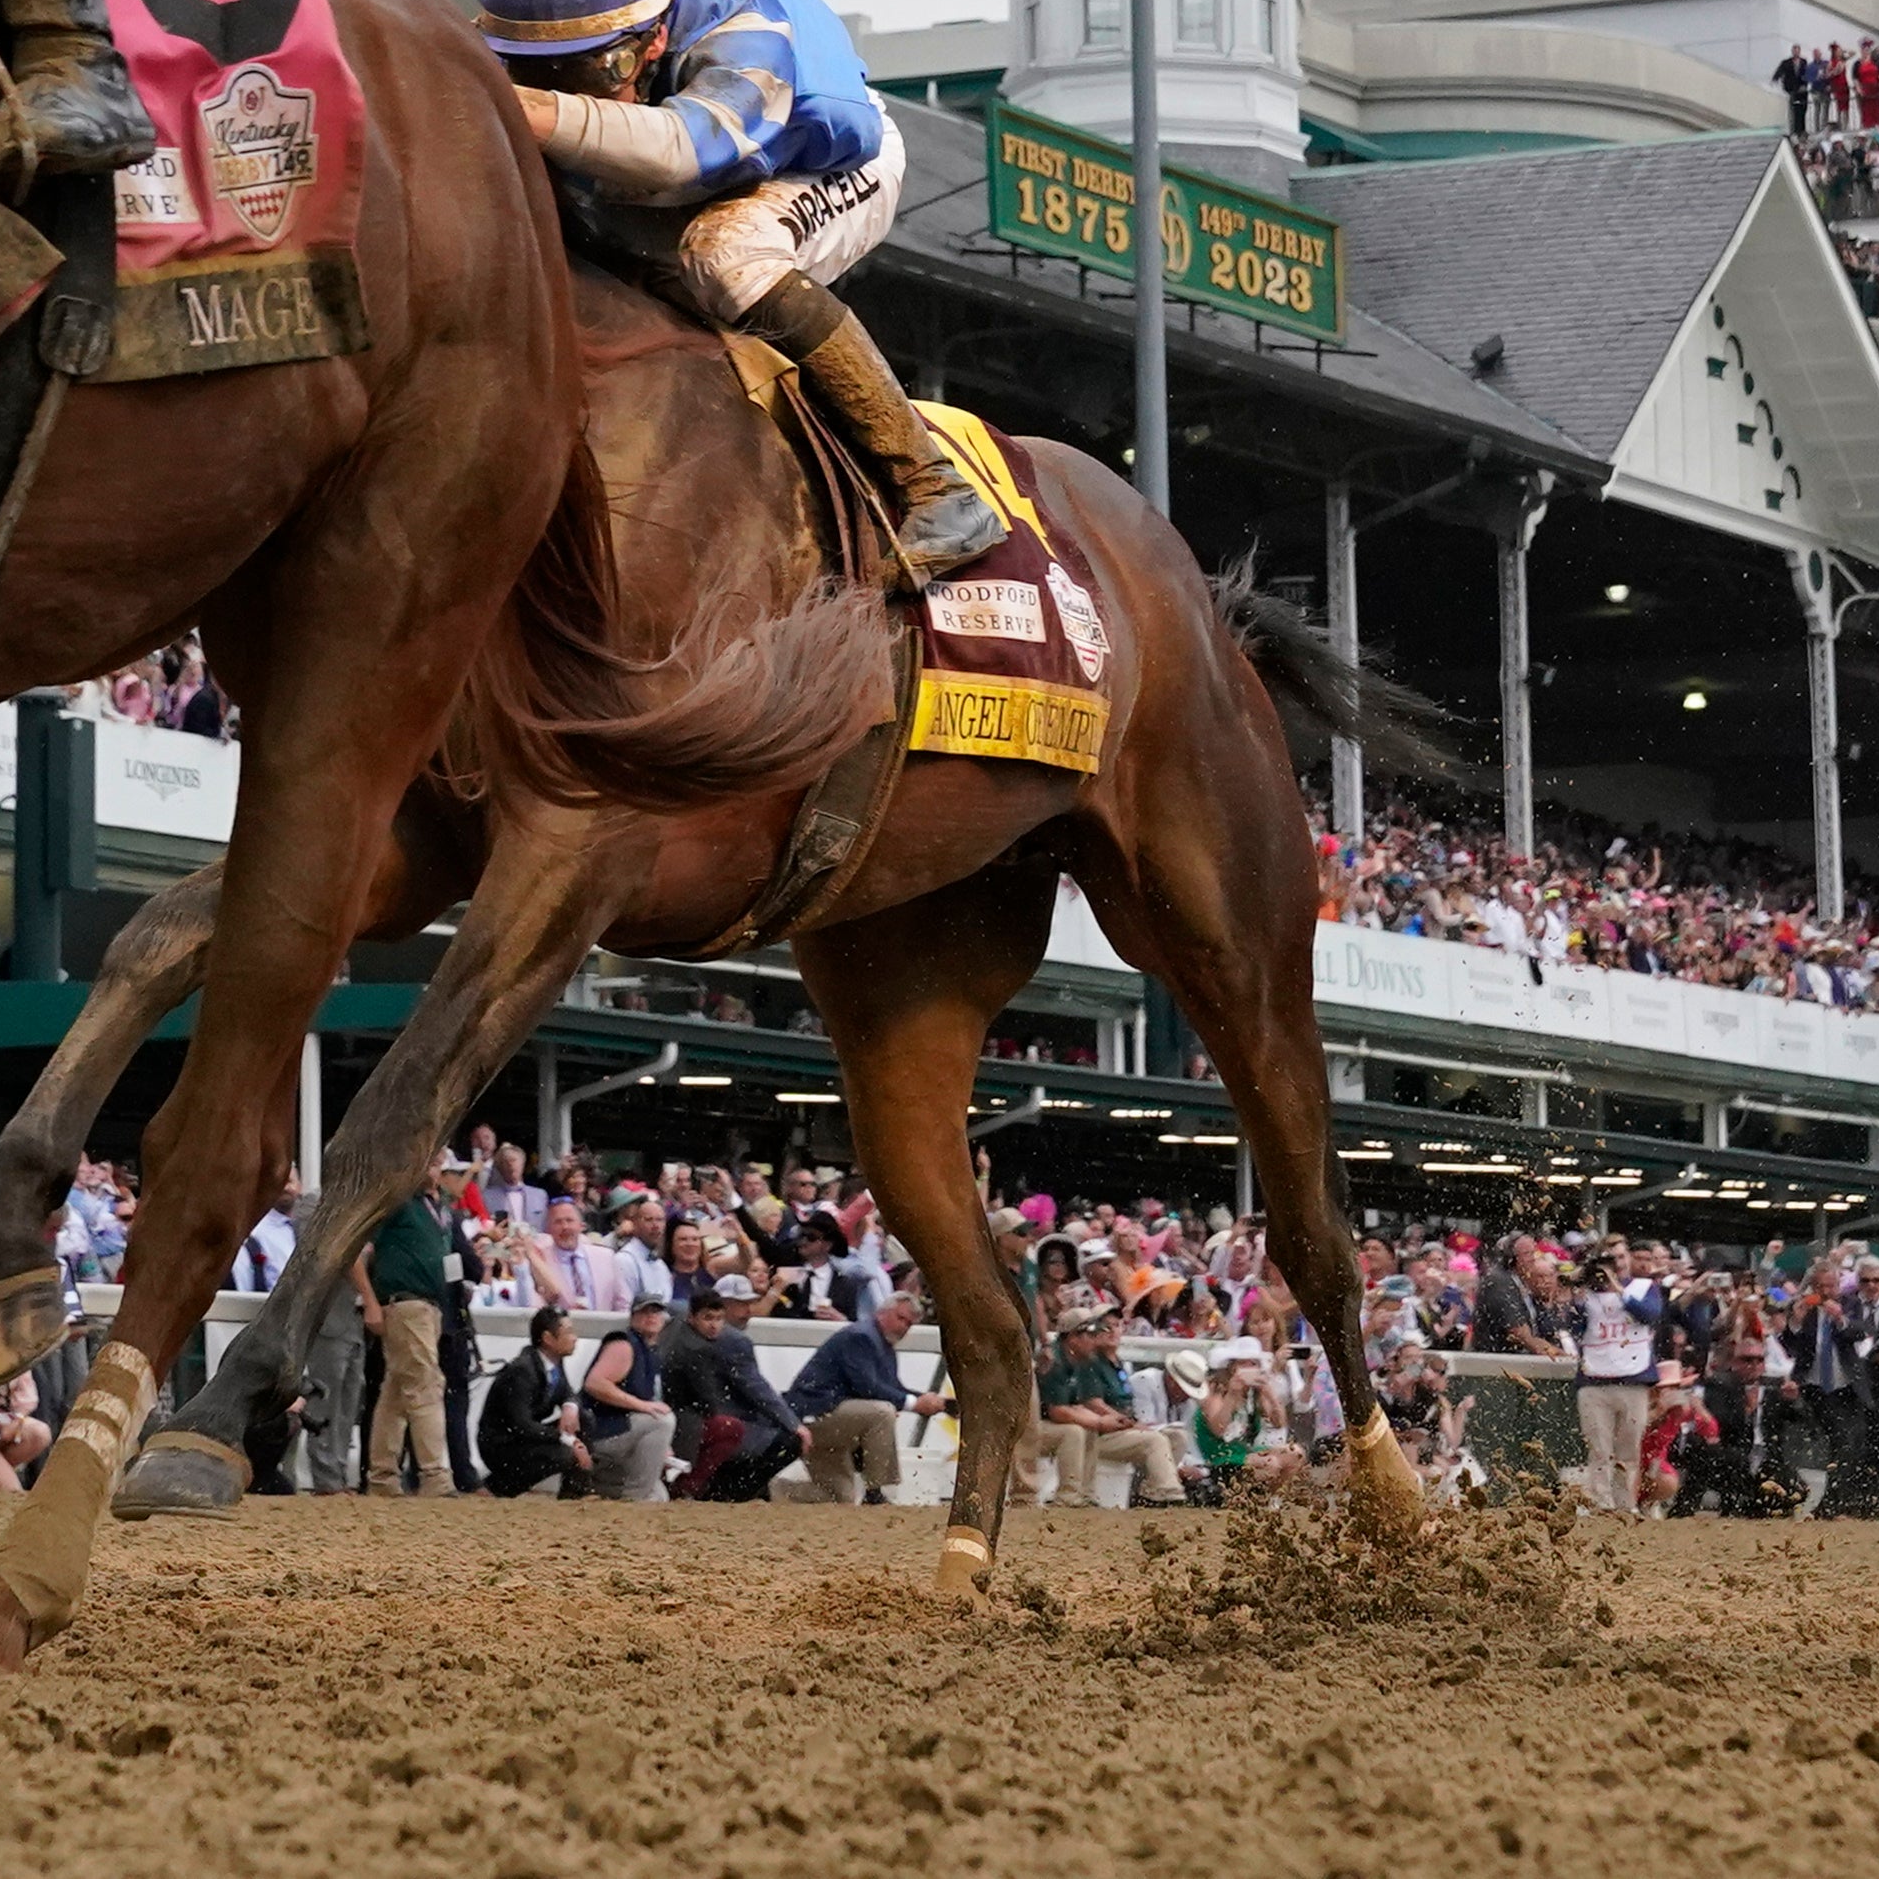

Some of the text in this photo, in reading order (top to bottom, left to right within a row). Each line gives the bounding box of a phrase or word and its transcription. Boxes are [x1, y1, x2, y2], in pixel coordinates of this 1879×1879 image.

[215, 112, 301, 156] Kentucky
[1001, 132, 1068, 182] FIRST
[777, 167, 881, 253] DURACELL
[1016, 177, 1132, 253] 1875
[1253, 217, 1327, 269] DERBY
[1210, 242, 1315, 314] 2023
[180, 277, 322, 347] MAGE
[925, 581, 1038, 607] WOODFORD
[942, 609, 1035, 635] RESERVE
[930, 691, 1013, 742] ANGEL
[124, 758, 202, 788] LONGINES
